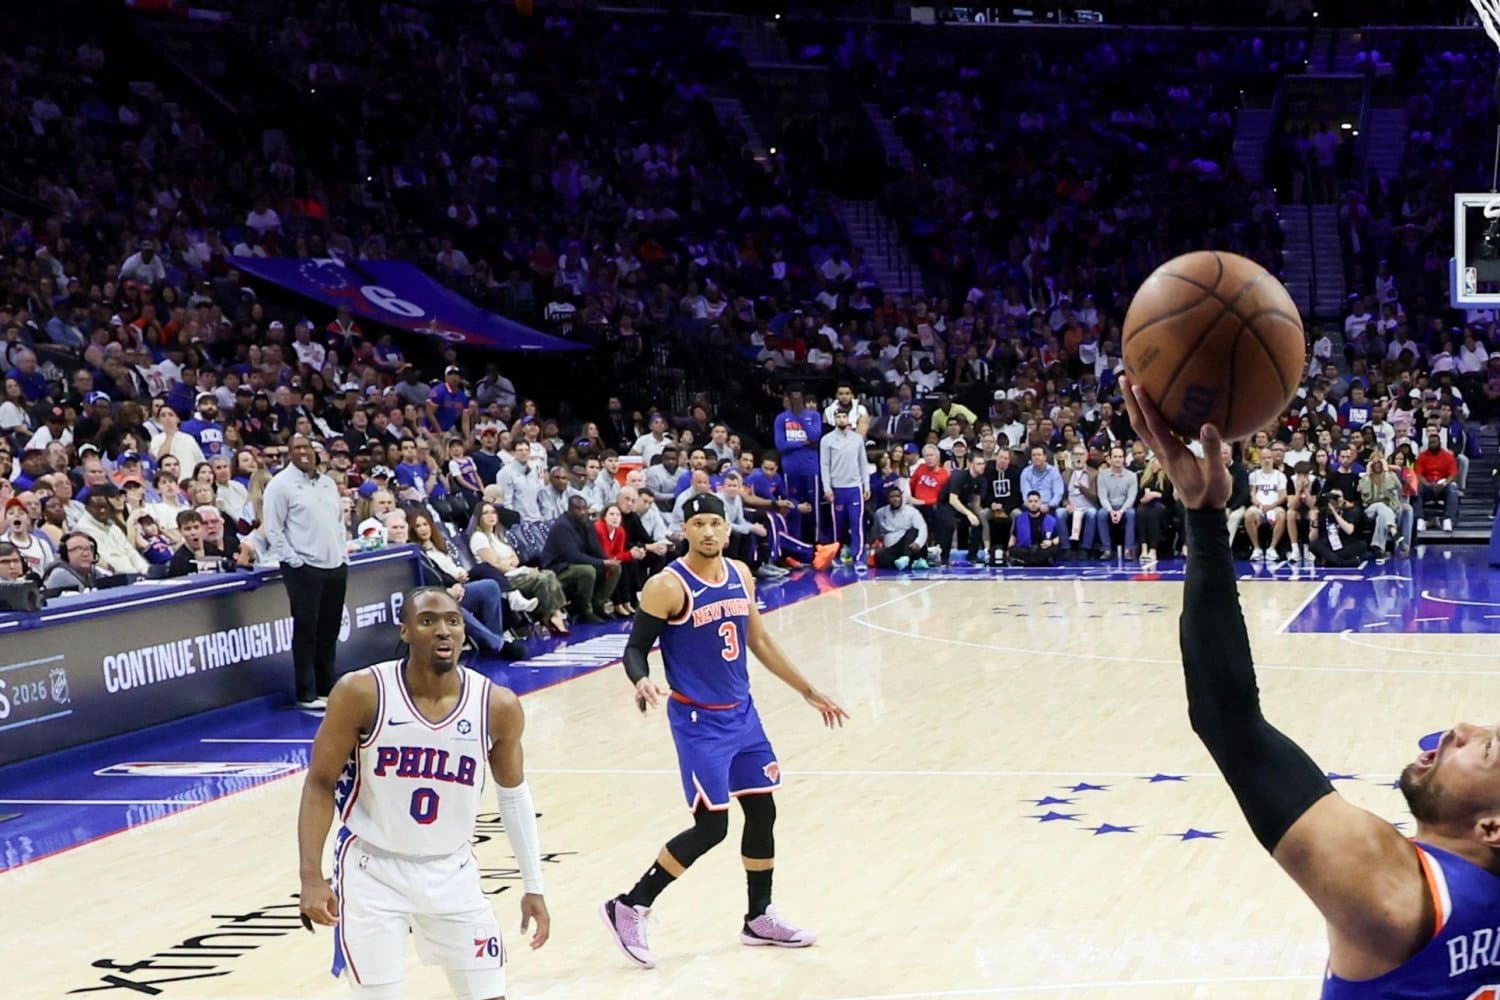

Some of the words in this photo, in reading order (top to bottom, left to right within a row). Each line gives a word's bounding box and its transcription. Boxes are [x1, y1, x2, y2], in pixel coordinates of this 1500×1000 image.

[356, 602, 387, 628] ESPN
[692, 603, 720, 628] NEW
[718, 621, 739, 661] 3
[103, 638, 196, 693] CONTINUE
[195, 621, 271, 671] THROUGH
[12, 681, 47, 706] 2026
[374, 746, 477, 786] PHILA
[410, 787, 440, 824] 0
[474, 936, 499, 958] 76
